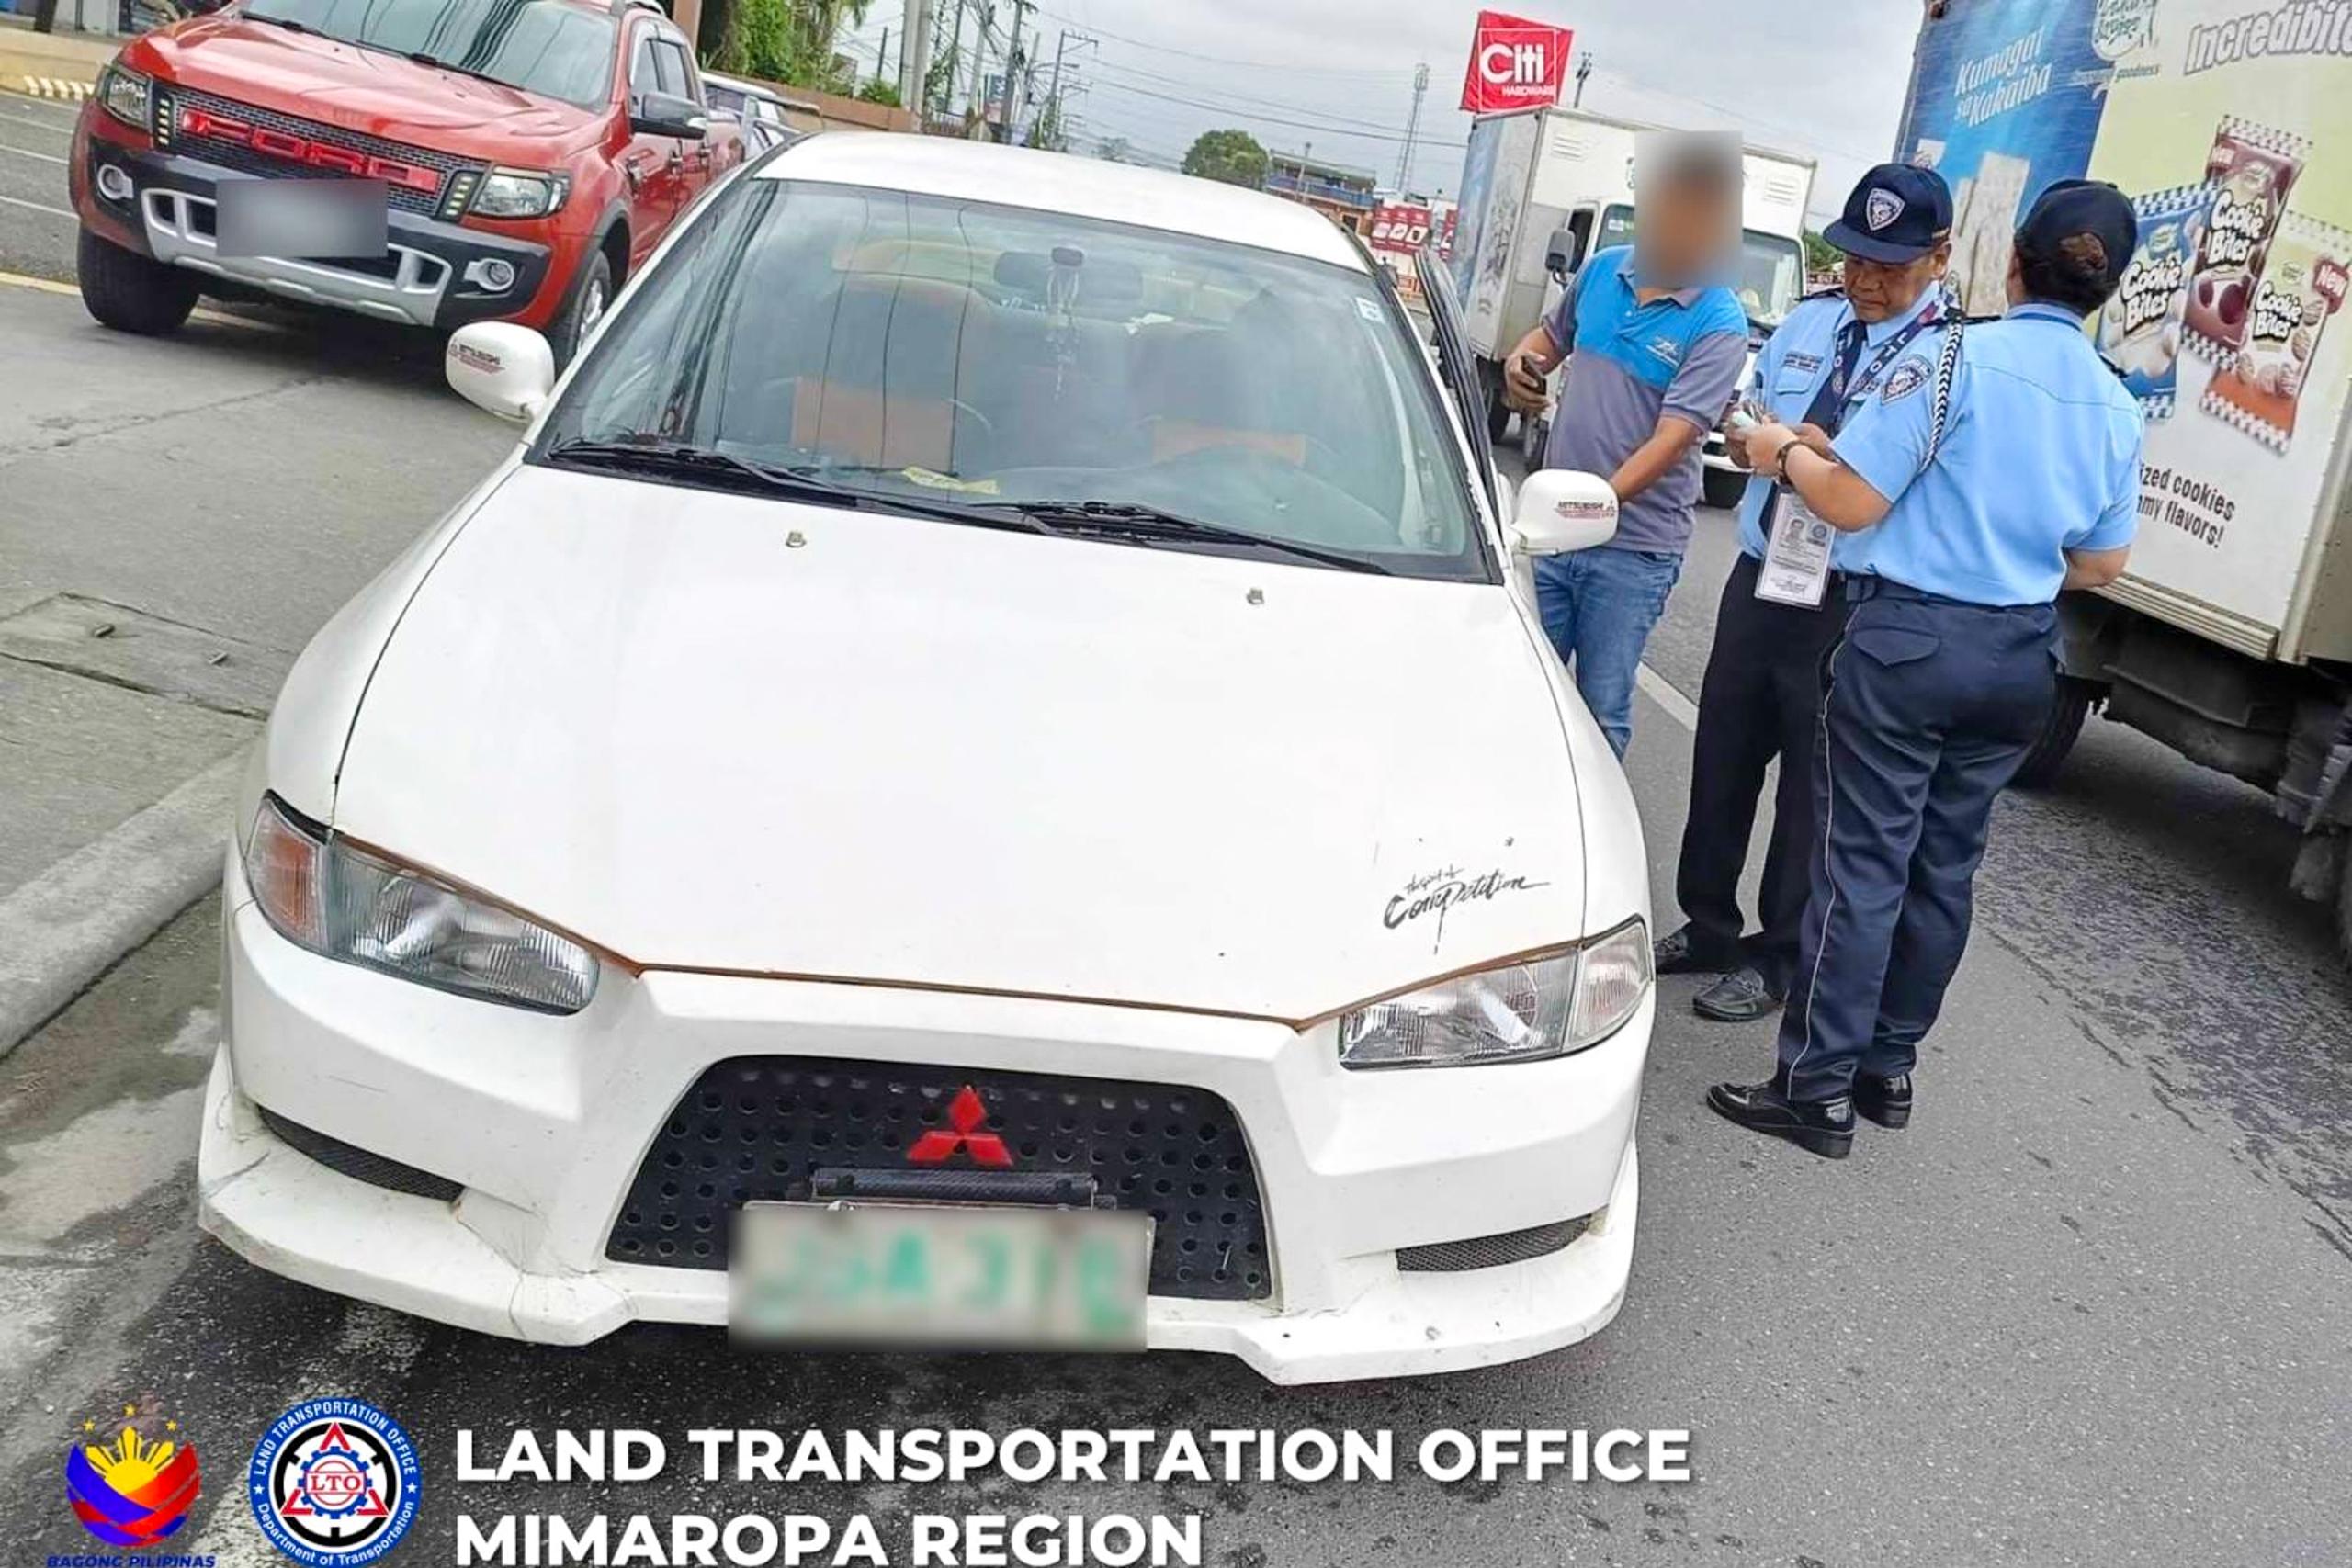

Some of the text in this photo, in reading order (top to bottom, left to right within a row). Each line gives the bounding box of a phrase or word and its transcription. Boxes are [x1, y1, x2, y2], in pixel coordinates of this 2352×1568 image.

[1954, 25, 2045, 96] Kumagat
[1502, 85, 1555, 96] HARDWARE
[1969, 62, 2052, 127] Kakaiba
[2211, 189, 2265, 239] Cookie
[2207, 229, 2251, 265] Bites
[2120, 257, 2181, 300] Cookie
[2125, 291, 2168, 333] Bites
[2256, 280, 2303, 324] Cookie
[2253, 310, 2290, 340] Bites
[2172, 475, 2235, 522] cookies
[2165, 500, 2224, 548] flavors!
